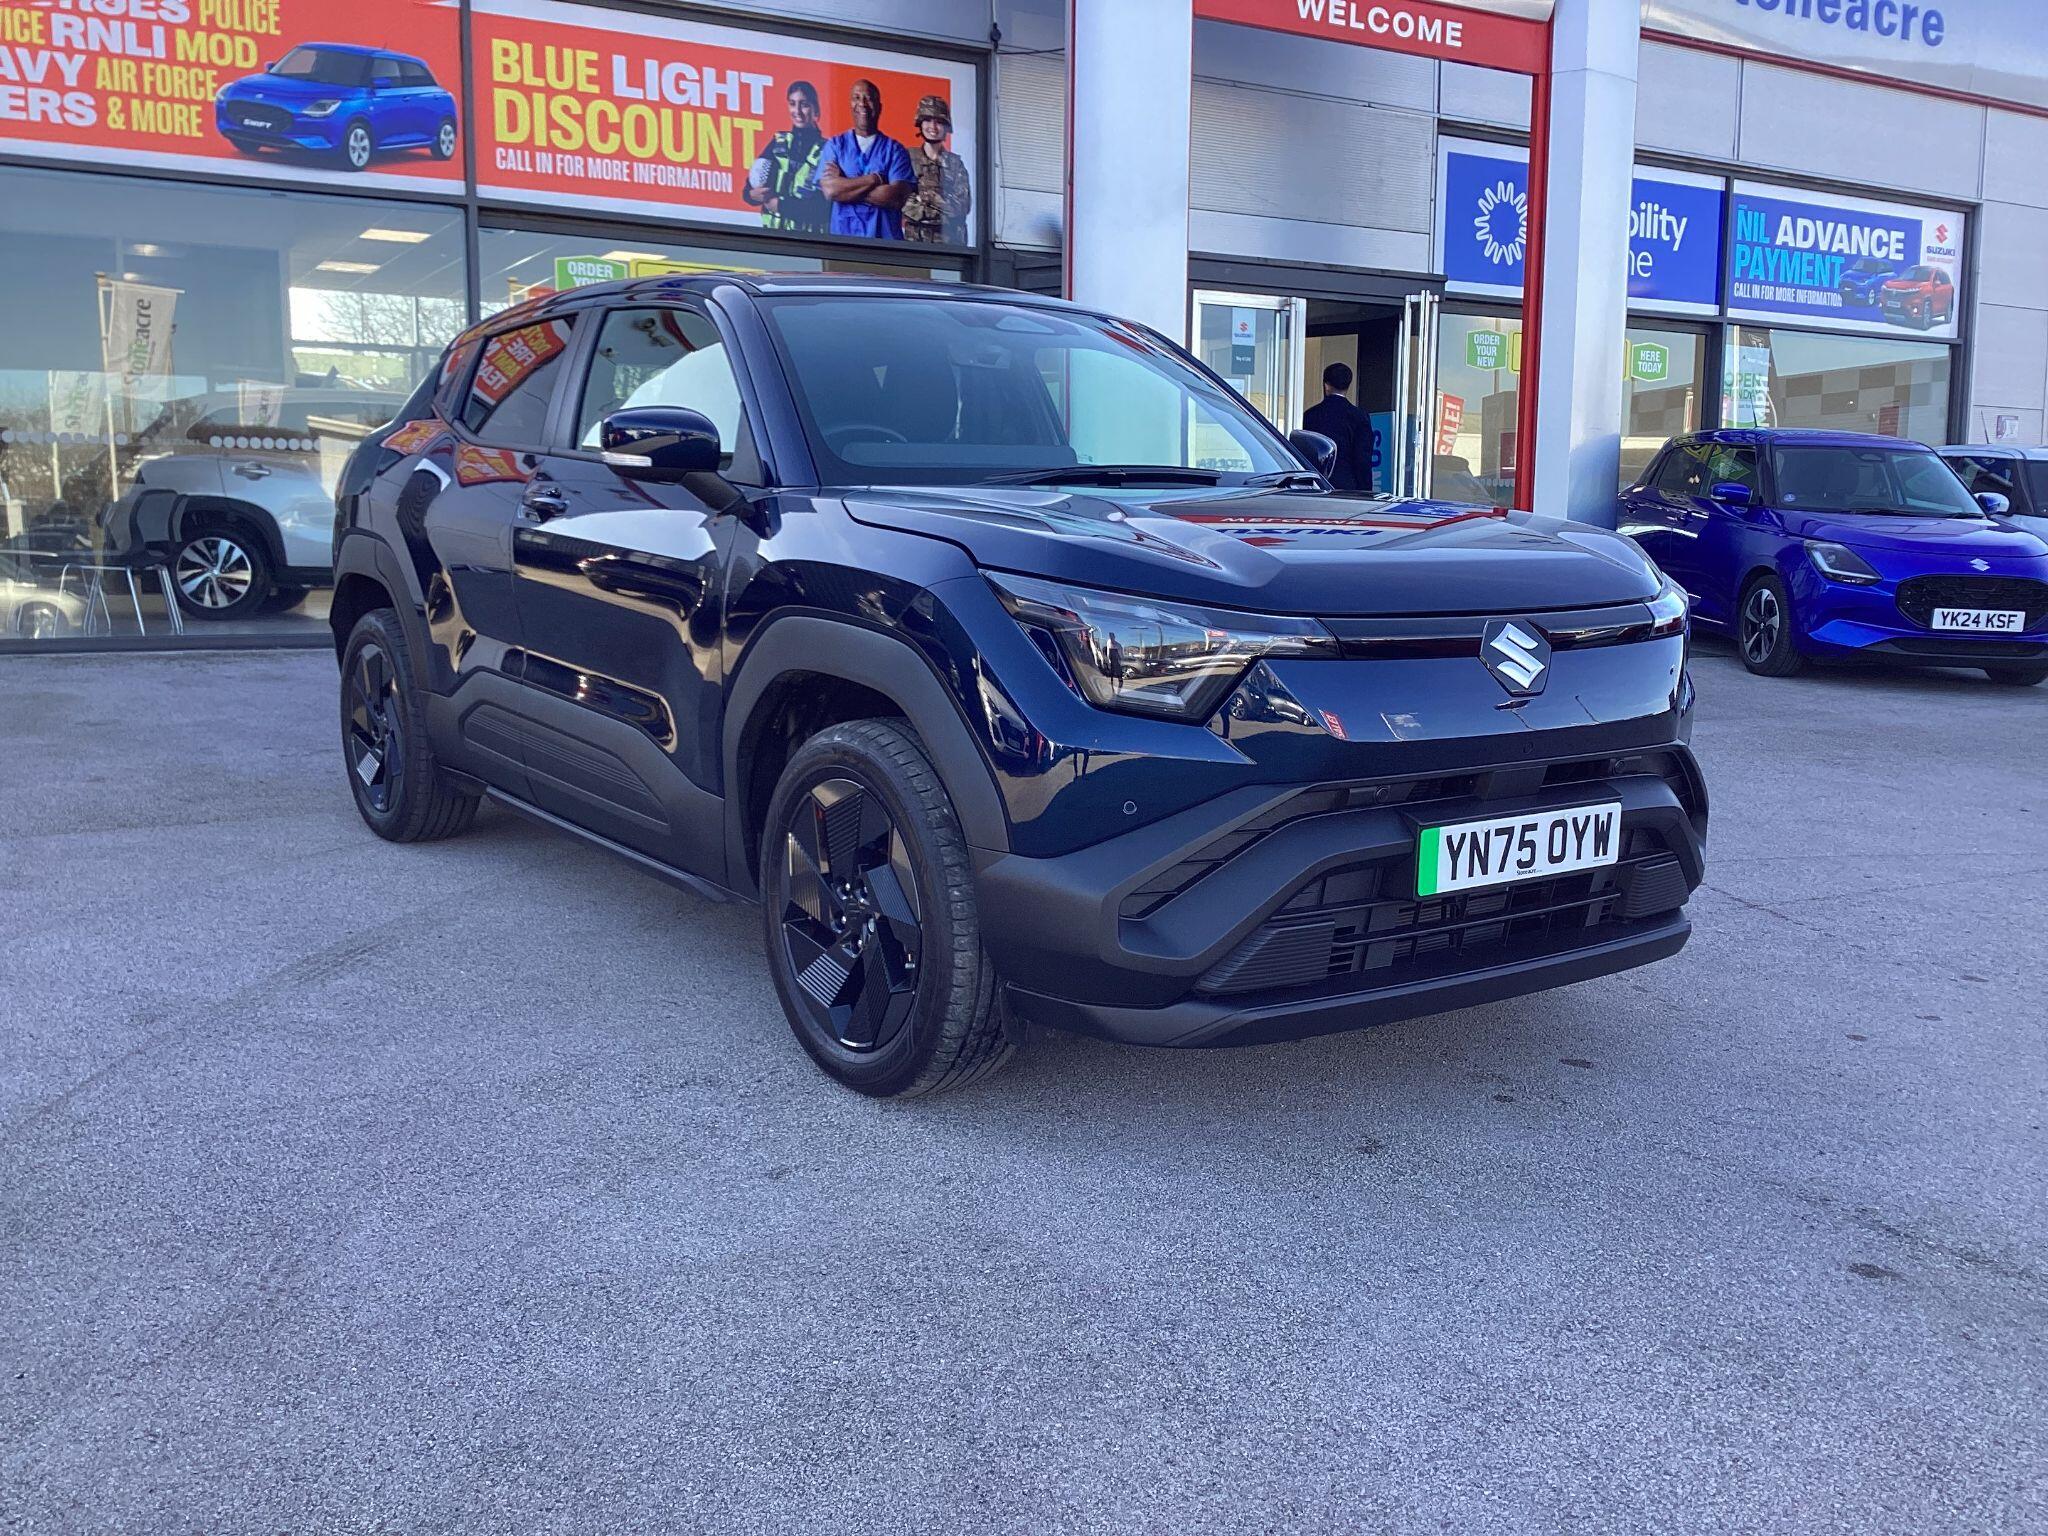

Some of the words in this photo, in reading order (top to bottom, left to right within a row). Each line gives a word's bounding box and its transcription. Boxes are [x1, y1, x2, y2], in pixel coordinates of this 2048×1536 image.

[0, 7, 45, 45] ICE
[51, 12, 167, 59] RNLI
[175, 28, 258, 69] MOD
[199, 0, 281, 36] POLICE
[1297, 0, 1463, 48] WELCOME
[96, 57, 138, 93] AIR
[142, 64, 218, 101] FORCE
[491, 38, 601, 94] BLUE
[611, 54, 774, 115] LIGHT
[107, 96, 126, 130] &
[131, 99, 204, 138] MORE
[492, 87, 764, 170] DISCOUNT
[495, 147, 533, 173] CALL
[535, 150, 552, 174] IN
[556, 153, 585, 178] FOR
[588, 157, 630, 183] MORE
[633, 162, 734, 194] INFORMATION
[1775, 215, 1906, 261] ADVANCE
[1926, 245, 1956, 257] SUZUKI
[567, 260, 614, 280] ORDER
[1734, 243, 1846, 289] PAYMENT
[1734, 281, 1751, 299] CALL
[1752, 284, 1760, 300] IN
[1761, 285, 1775, 301] FOR
[1775, 286, 1796, 303] MORE
[1796, 289, 1843, 308] INFORMATION
[1473, 333, 1500, 346] ORDER
[1476, 345, 1497, 357] YOUR
[1640, 349, 1661, 362] HERE
[1477, 355, 1495, 367] NEW
[1637, 360, 1663, 374] TODAY
[1439, 402, 1461, 456] SALE!
[1941, 610, 1981, 628] YK24
[1985, 612, 2018, 630] KSF
[1445, 822, 1539, 881] YN75
[1547, 811, 1613, 864] OYW
